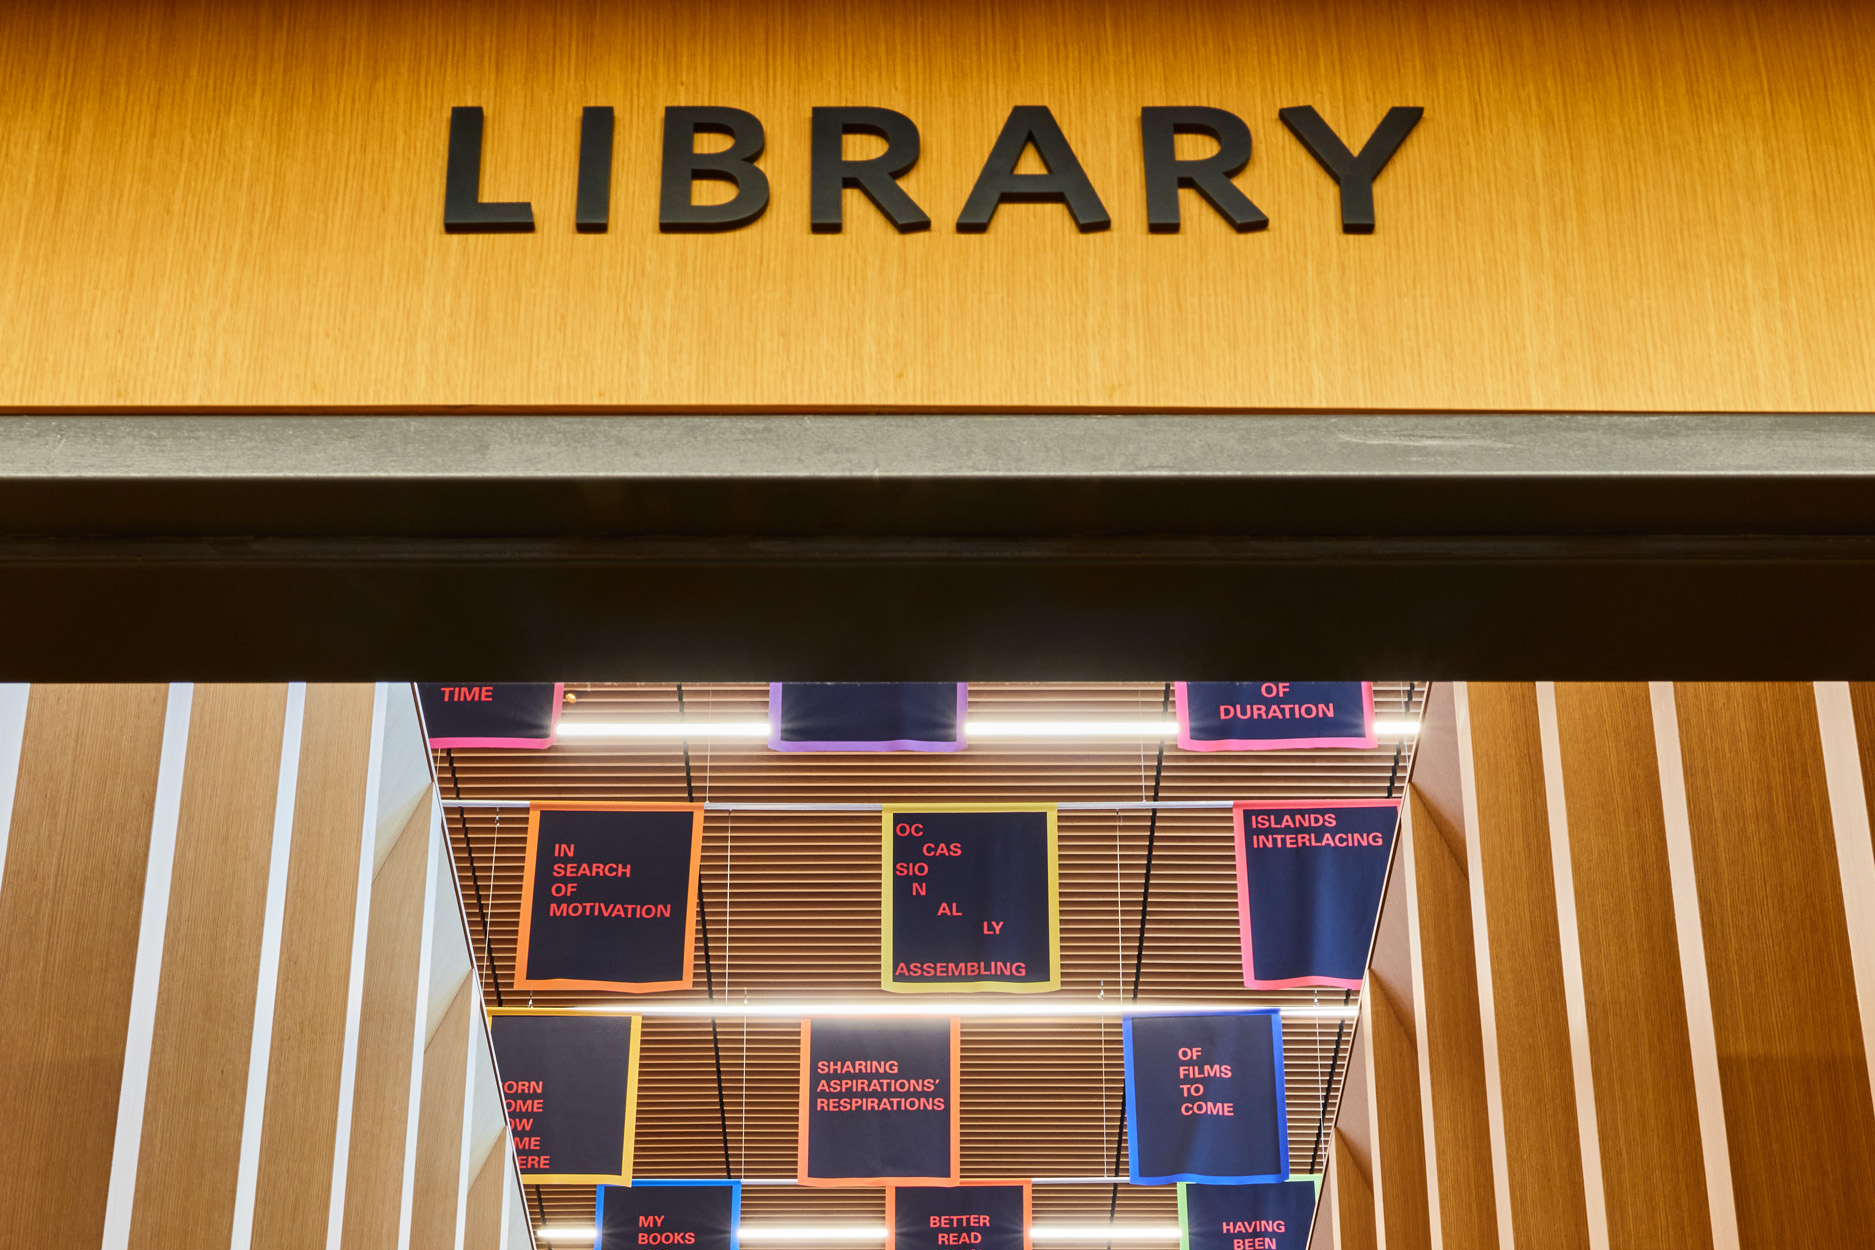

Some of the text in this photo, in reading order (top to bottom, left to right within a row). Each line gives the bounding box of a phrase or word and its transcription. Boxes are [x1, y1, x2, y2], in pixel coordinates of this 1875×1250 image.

[443, 105, 1425, 235] LIBRARY
[440, 686, 494, 702] TIME
[1260, 682, 1290, 698] OF
[1219, 703, 1334, 720] DURATION
[1251, 813, 1337, 829] ISLANDS
[895, 823, 924, 837] OC
[1252, 832, 1383, 849] INTERLACING
[554, 843, 575, 858] IN
[922, 842, 962, 857] CAS
[552, 863, 631, 878] SEARCH
[895, 862, 929, 877] SIO
[551, 883, 578, 897] OF
[912, 882, 927, 896] N
[549, 902, 671, 919] MOTIVATION
[937, 902, 963, 916] AL
[983, 921, 1004, 935] LY
[895, 961, 1026, 977] ASSEMBLING
[1177, 1047, 1202, 1061] OF
[817, 1060, 899, 1075] SHARING
[1179, 1064, 1232, 1080] FILMS
[501, 1080, 543, 1094] ORN
[1179, 1083, 1205, 1098] TO
[816, 1097, 945, 1112] RESPIRATIONS
[1180, 1101, 1234, 1117] COME
[638, 1215, 665, 1228] MY
[929, 1214, 990, 1228] BETTER
[1222, 1219, 1286, 1234] HAVING
[637, 1231, 696, 1246] BOOKS
[937, 1231, 982, 1246] READ
[1233, 1237, 1277, 1250] BEEN
